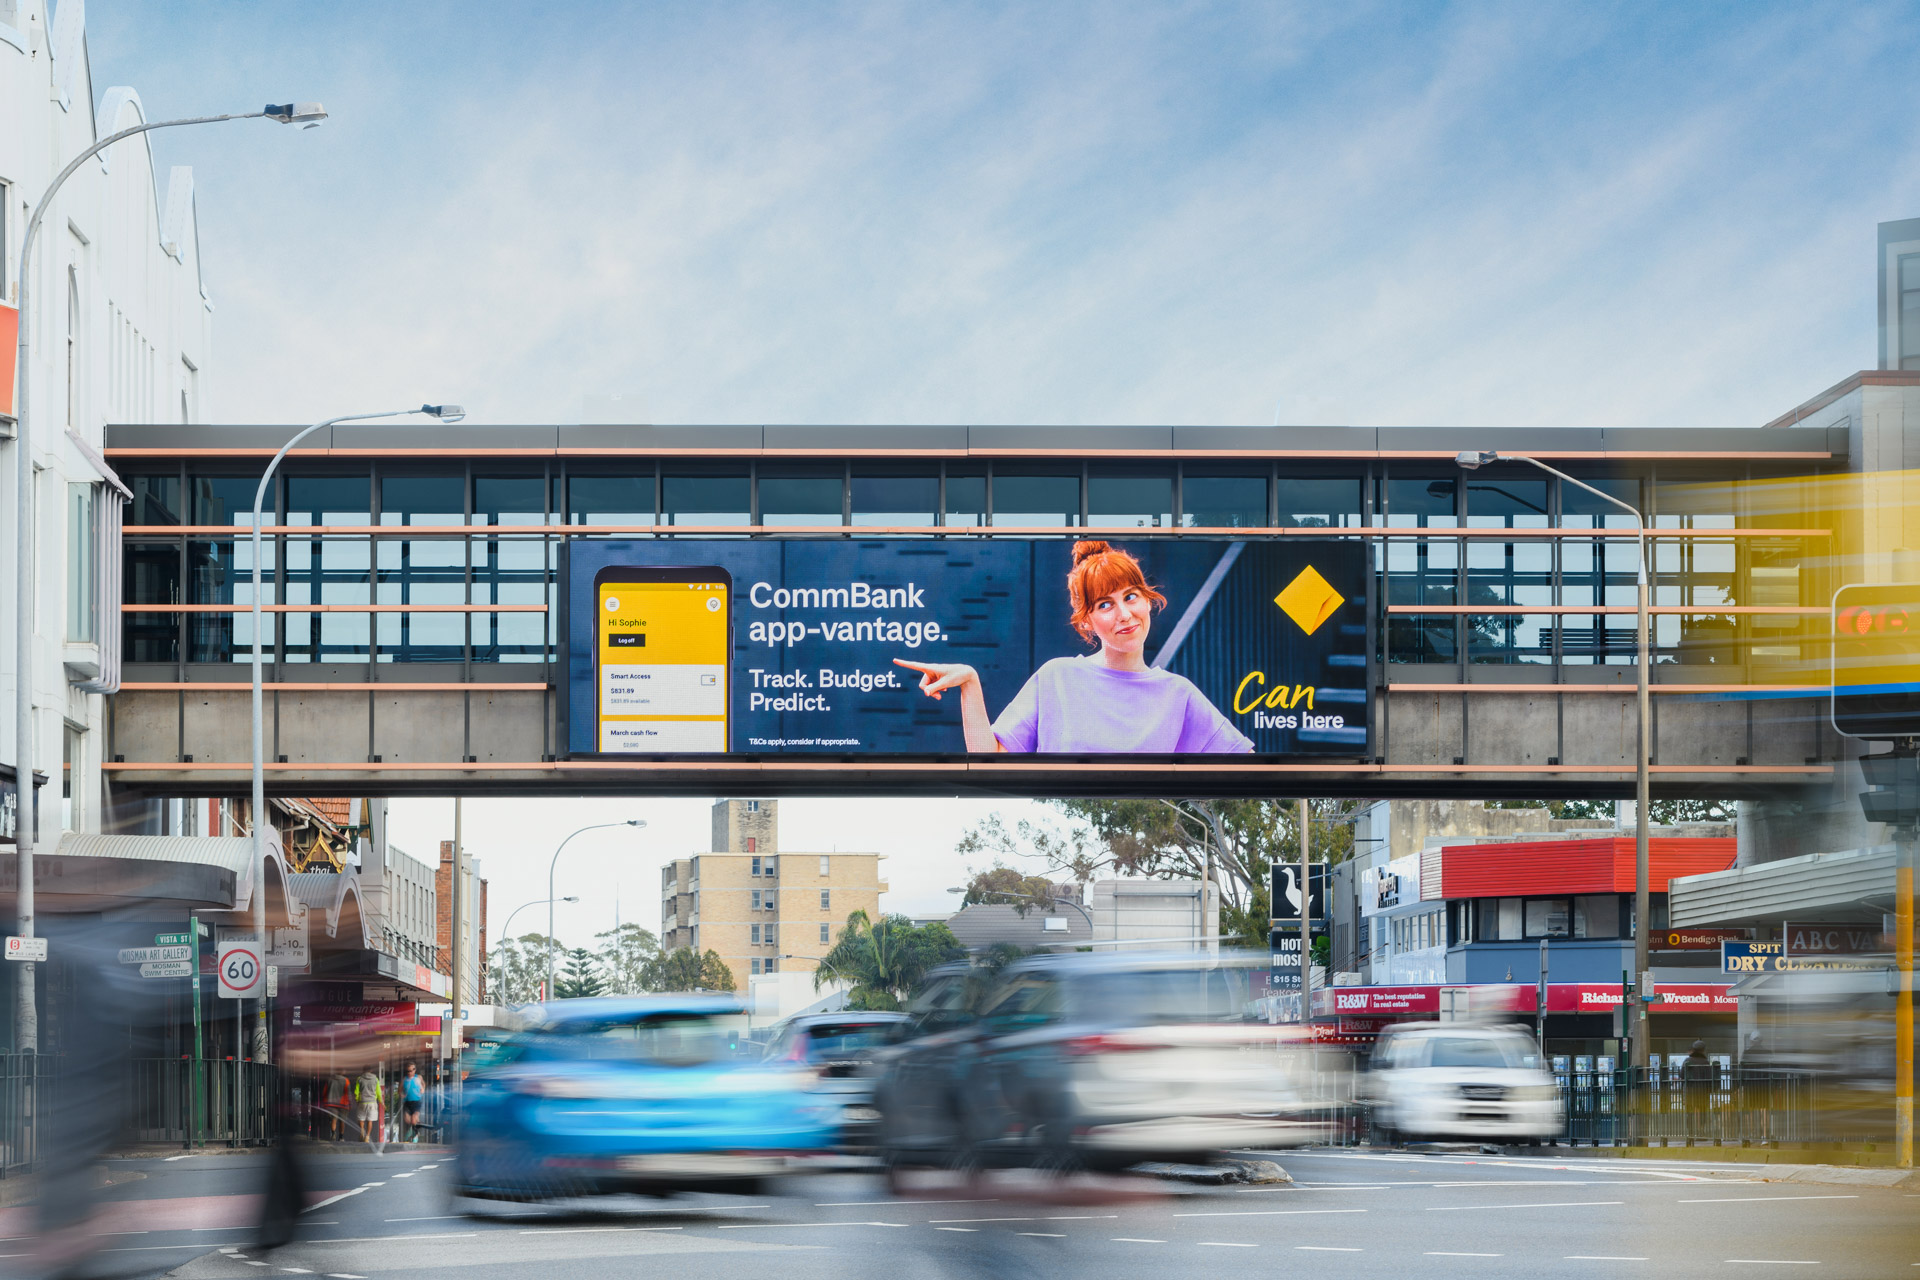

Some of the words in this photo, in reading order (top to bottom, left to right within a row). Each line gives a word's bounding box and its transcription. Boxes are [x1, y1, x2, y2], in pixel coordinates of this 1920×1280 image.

[750, 582, 925, 608] CommBank
[619, 619, 647, 628] Sophie
[749, 616, 948, 648] app-vantage.
[749, 669, 813, 688] Track.
[819, 669, 901, 692] Budget.
[1234, 671, 1315, 714] Can
[750, 692, 831, 711] Predict.
[1254, 711, 1297, 729] lives
[1302, 711, 1344, 729] here
[180, 935, 188, 943] ST
[1281, 938, 1314, 951] HOTL
[1681, 935, 1716, 945] Bendigo
[1792, 930, 1839, 950] ABC
[121, 949, 147, 962] MOSMAN
[149, 949, 160, 960] ART
[162, 948, 189, 960] GALLERY
[1749, 943, 1782, 953] SPIT
[227, 960, 254, 979] 60
[1727, 956, 1768, 971] DRY
[1273, 975, 1290, 983] $15
[1336, 994, 1369, 1009] R&W
[1397, 993, 1426, 1001] reputation
[1662, 992, 1710, 1004] Wrench
